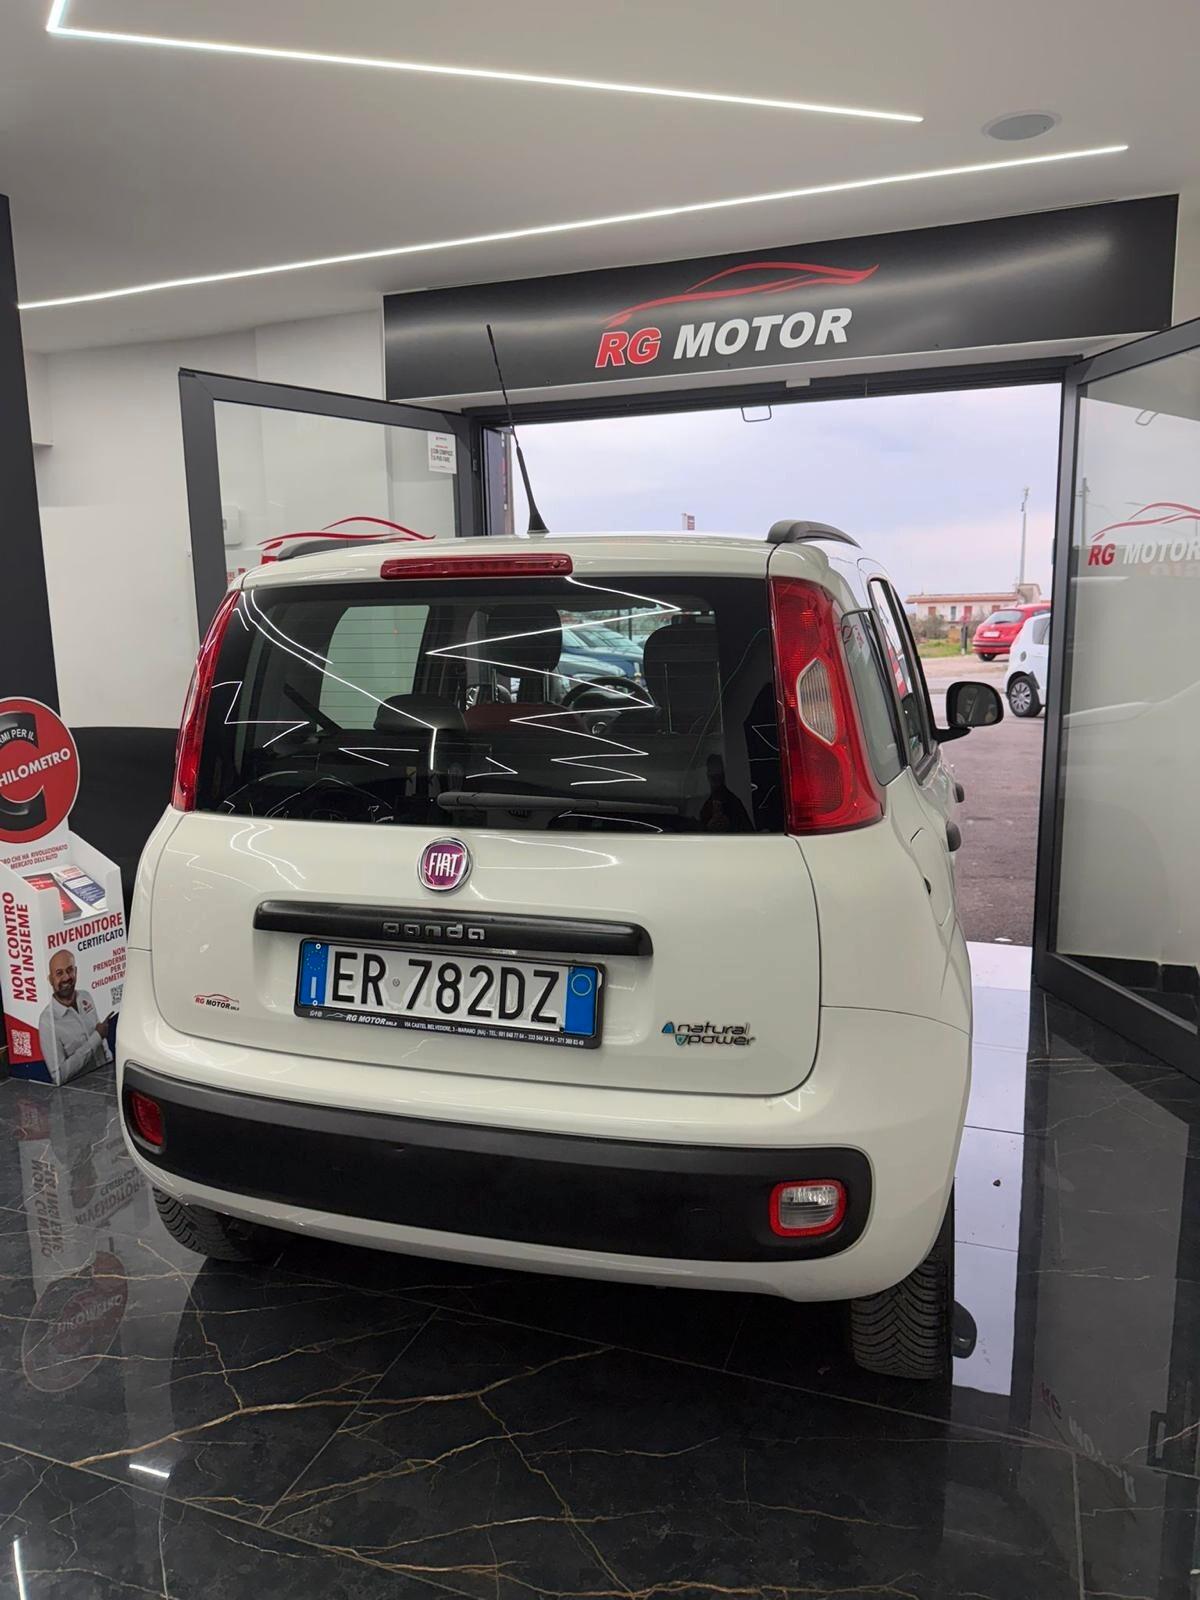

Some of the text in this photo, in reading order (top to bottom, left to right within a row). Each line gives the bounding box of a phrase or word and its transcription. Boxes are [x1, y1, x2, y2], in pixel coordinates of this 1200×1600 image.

[595, 308, 852, 368] RG MOTOR
[1088, 538, 1200, 566] RG MOTOR
[11, 728, 27, 739] PER
[28, 730, 35, 741] IL
[0, 748, 71, 788] HILOMETRO
[428, 852, 459, 877] FIAT
[47, 912, 123, 949] RIVENDITORE
[77, 928, 124, 952] CERTIFICATO
[383, 922, 485, 940] panda
[2, 892, 25, 1001] NON CONTRO
[16, 904, 38, 1003] MA INSIEME
[112, 947, 125, 956] NON
[93, 954, 126, 972] PRENDERMI
[110, 964, 121, 973] PER
[91, 970, 125, 989] CHILOMETR
[331, 951, 560, 1024] ER 782DZ
[206, 999, 230, 1009] MOTOR
[358, 1015, 386, 1025] MOTOR
[677, 1021, 751, 1035] natural
[687, 1034, 756, 1046] power
